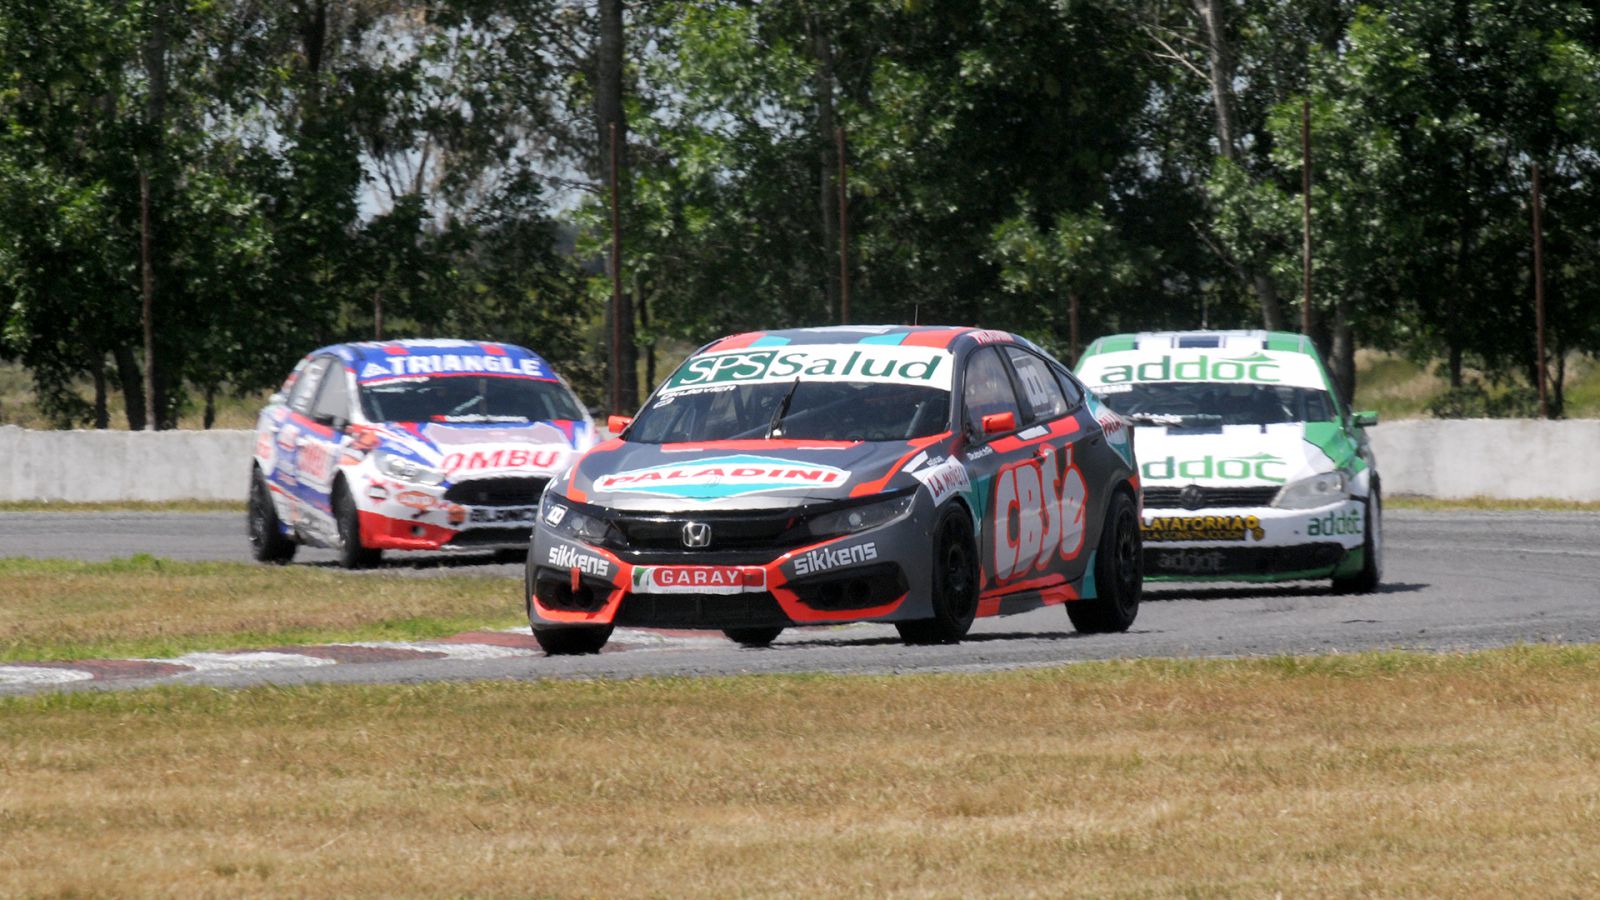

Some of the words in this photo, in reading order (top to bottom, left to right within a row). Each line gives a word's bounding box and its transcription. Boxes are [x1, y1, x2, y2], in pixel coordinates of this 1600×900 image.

[386, 354, 543, 376] TRIANGLE
[680, 351, 773, 385] SPS
[771, 350, 942, 381] Salud
[1100, 353, 1281, 384] addoc
[441, 449, 560, 472] OMBU
[1142, 455, 1287, 482] ddoc
[603, 465, 841, 488] PALADINI
[928, 474, 945, 497] LA
[1139, 515, 1243, 531] LATAFORMA
[548, 543, 610, 577] sikkens
[794, 541, 878, 576] sikkens
[661, 569, 739, 584] GARAY
